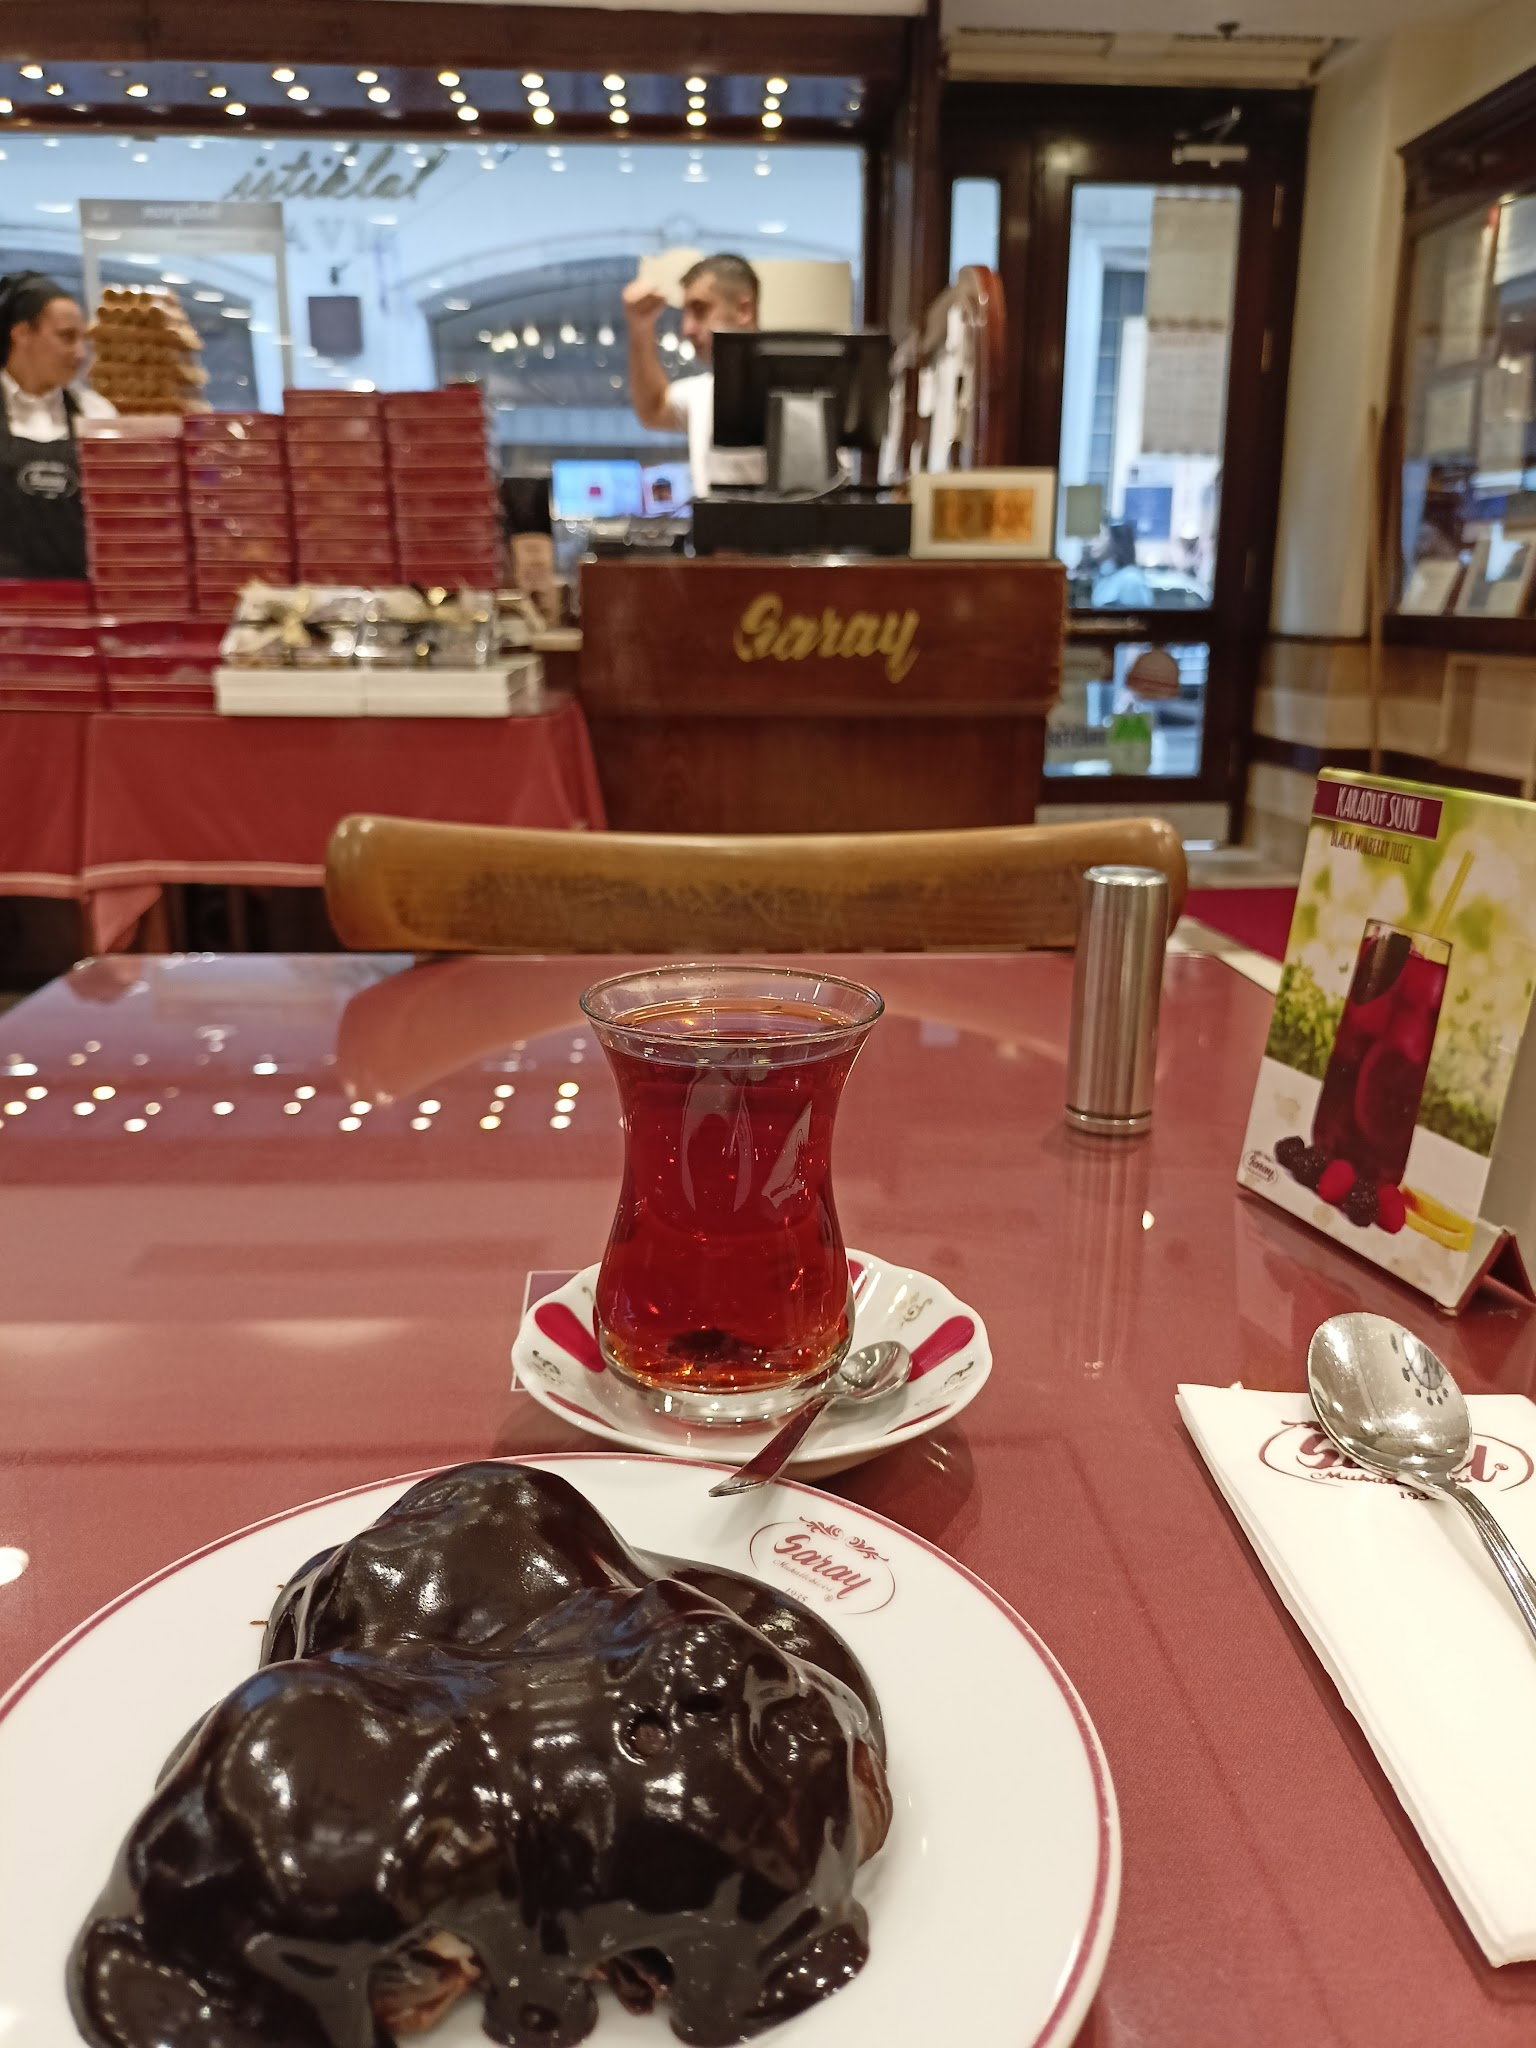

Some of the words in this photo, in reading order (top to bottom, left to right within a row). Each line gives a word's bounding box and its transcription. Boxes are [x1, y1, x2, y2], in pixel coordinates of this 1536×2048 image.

[733, 591, 920, 684] Saray
[1335, 786, 1388, 825] KARADUT
[1386, 794, 1422, 832] SUYU
[1330, 829, 1355, 850] BLACK
[1354, 833, 1390, 858] MULBERRY
[1389, 841, 1412, 864] JUICE
[774, 1534, 871, 1599] Saray
